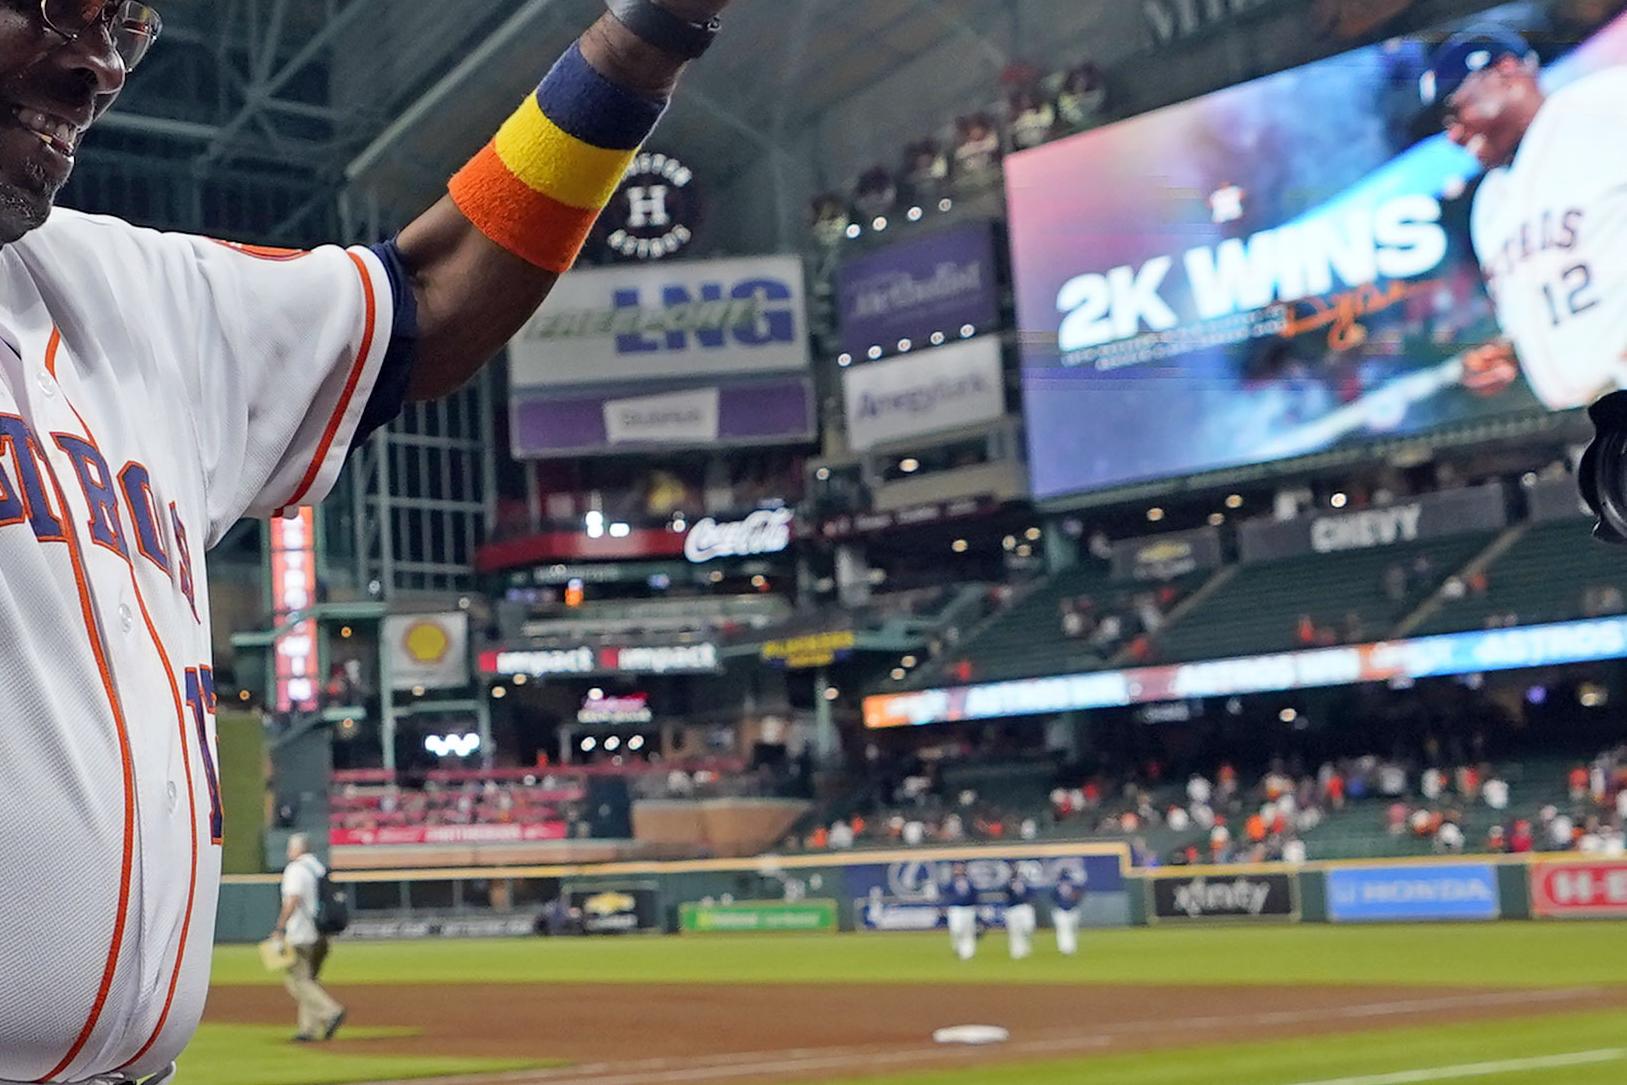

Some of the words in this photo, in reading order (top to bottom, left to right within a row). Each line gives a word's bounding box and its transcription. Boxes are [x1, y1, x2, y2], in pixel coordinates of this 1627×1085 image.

[626, 185, 669, 227] H
[1056, 254, 1178, 353] 2K
[1184, 194, 1447, 319] WINS
[1541, 262, 1601, 327] 12
[614, 278, 795, 356] LNG
[185, 664, 223, 845] 1
[1174, 874, 1271, 916] xfinity
[1362, 878, 1493, 903] HONDA
